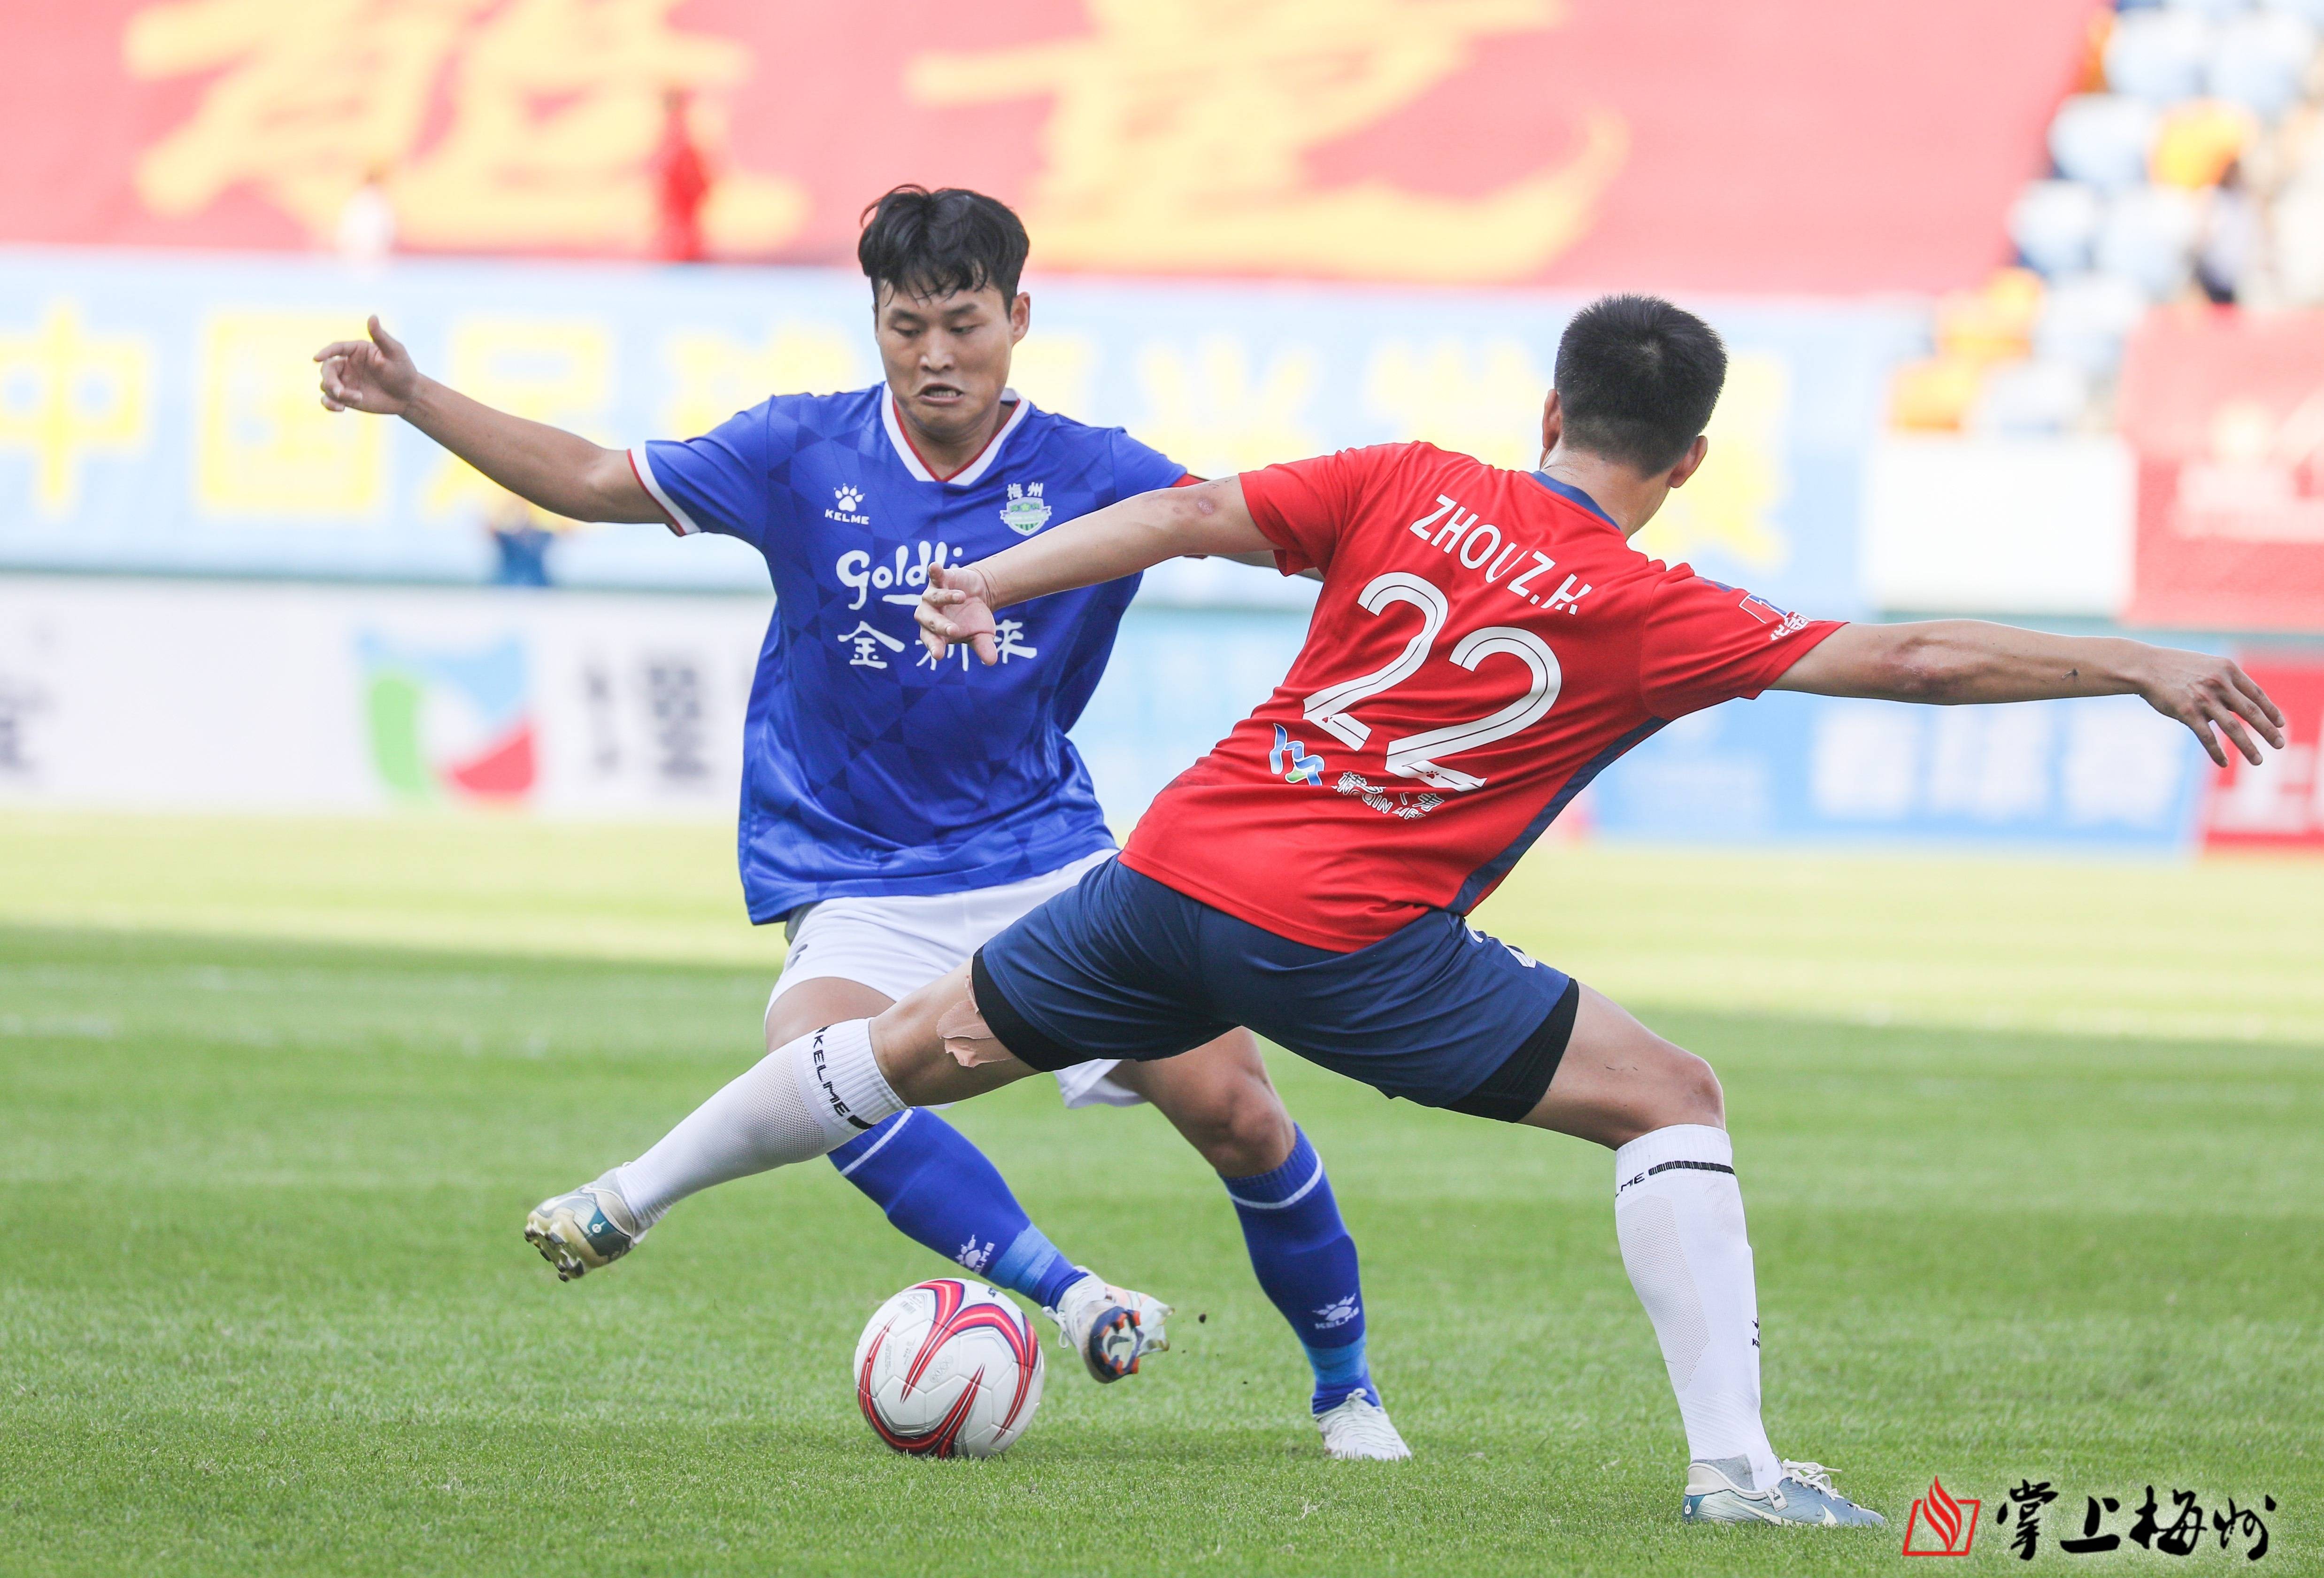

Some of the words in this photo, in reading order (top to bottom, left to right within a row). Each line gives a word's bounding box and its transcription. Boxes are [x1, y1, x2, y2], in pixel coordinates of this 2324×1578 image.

[825, 509, 870, 525] KELME
[836, 540, 980, 610] Goldli
[1302, 571, 1562, 792] 22
[813, 1034, 851, 1117] KELME
